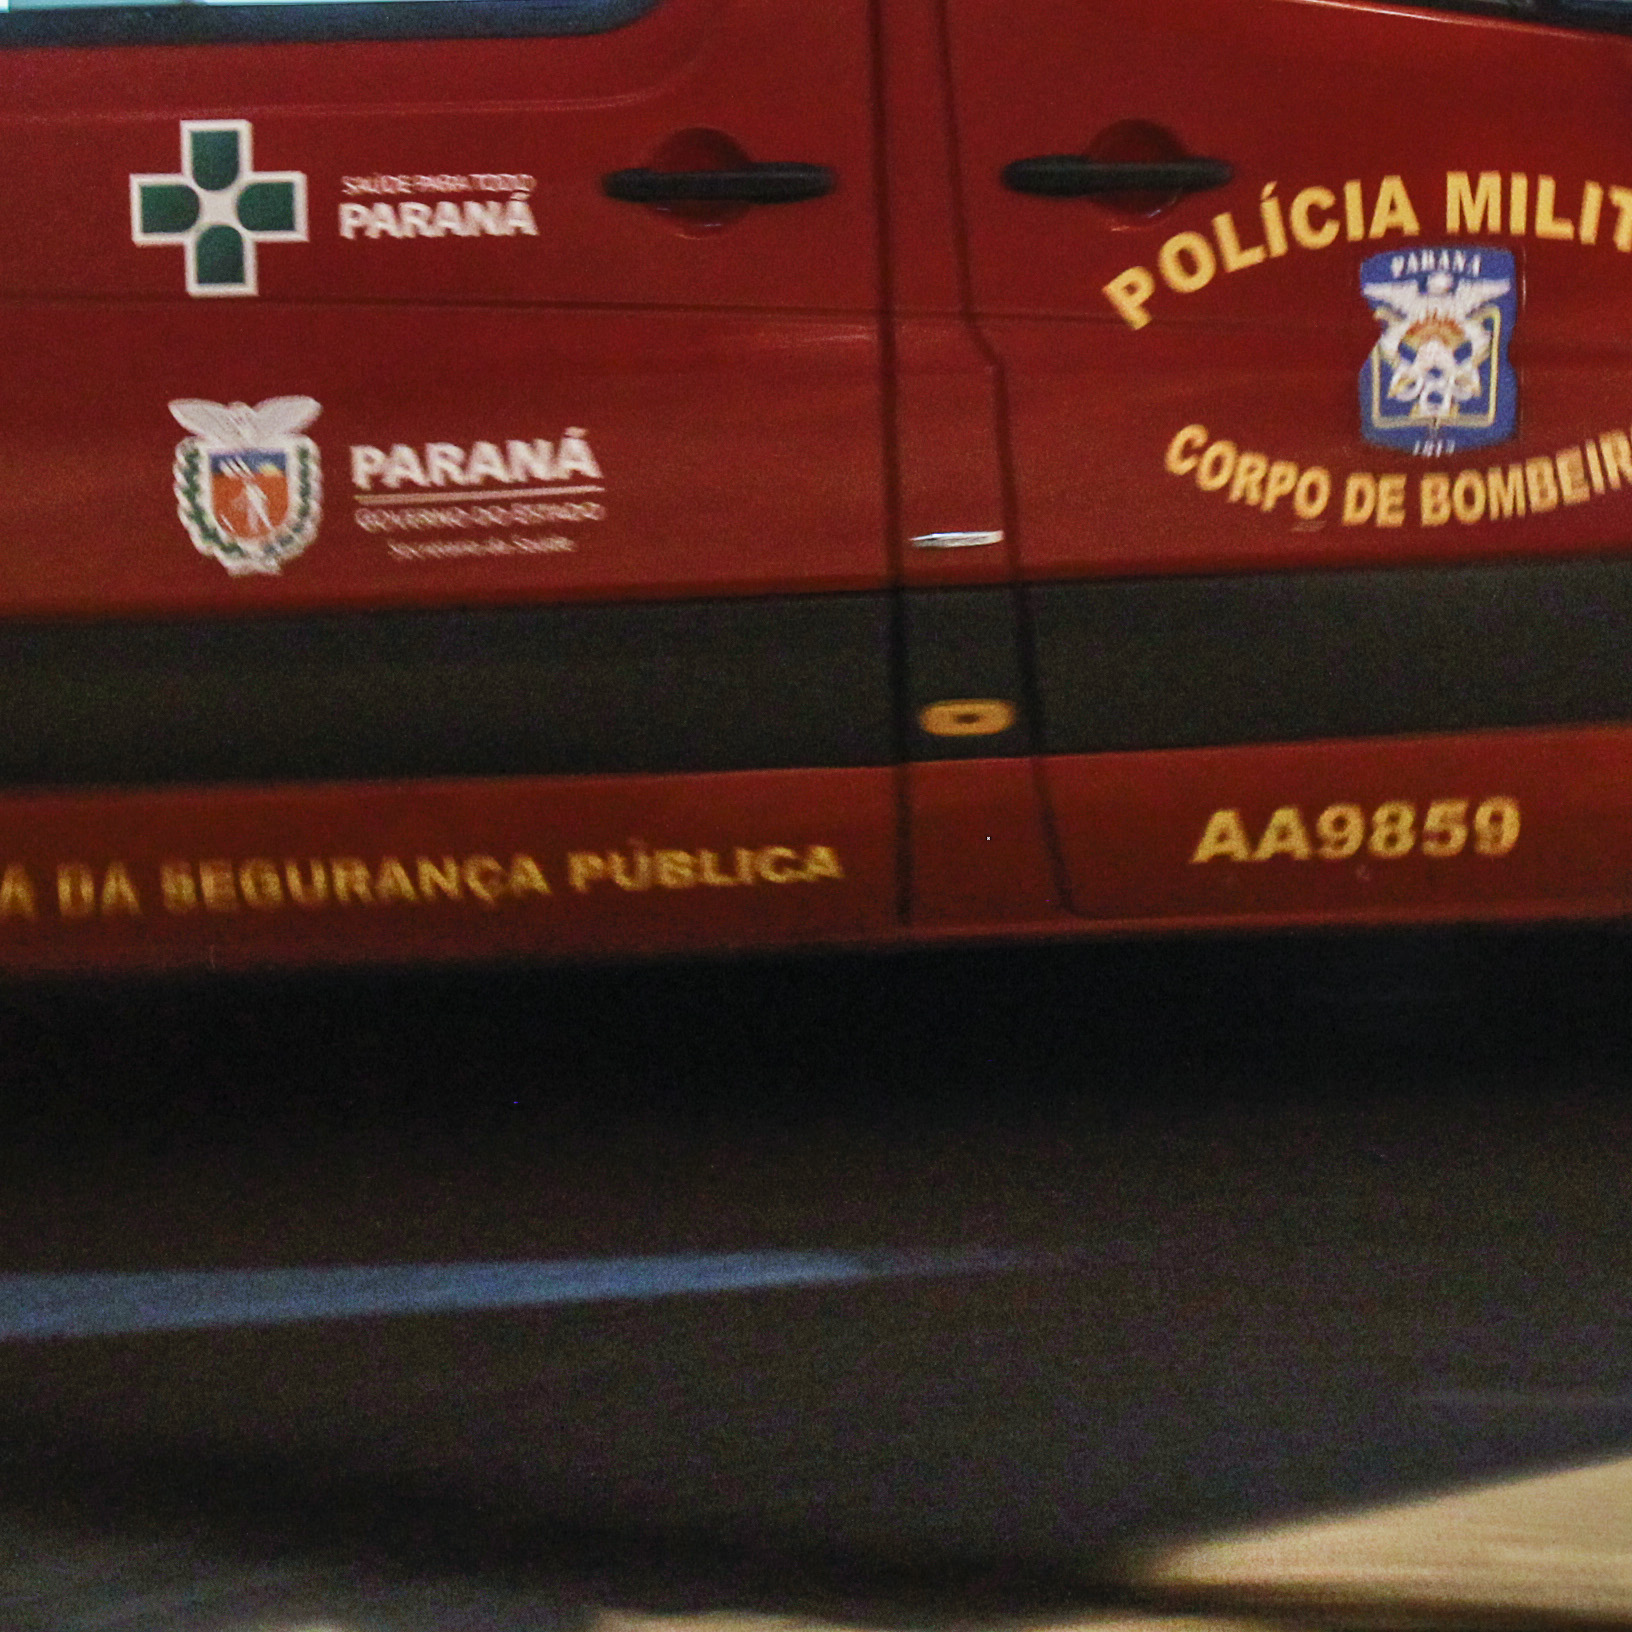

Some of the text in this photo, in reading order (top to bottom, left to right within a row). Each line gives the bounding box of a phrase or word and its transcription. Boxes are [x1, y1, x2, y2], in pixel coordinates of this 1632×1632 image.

[338, 192, 539, 240] PARANÁ
[1102, 175, 1419, 331] POLÍCIA
[349, 426, 604, 491] PARANÁ
[1165, 423, 1331, 520] CORPO
[1341, 472, 1407, 528] DE
[1189, 796, 1521, 863] AA9859
[55, 859, 142, 918] DA
[159, 854, 552, 914] SEGURANÇA
[568, 838, 844, 894] PÚBLICA
